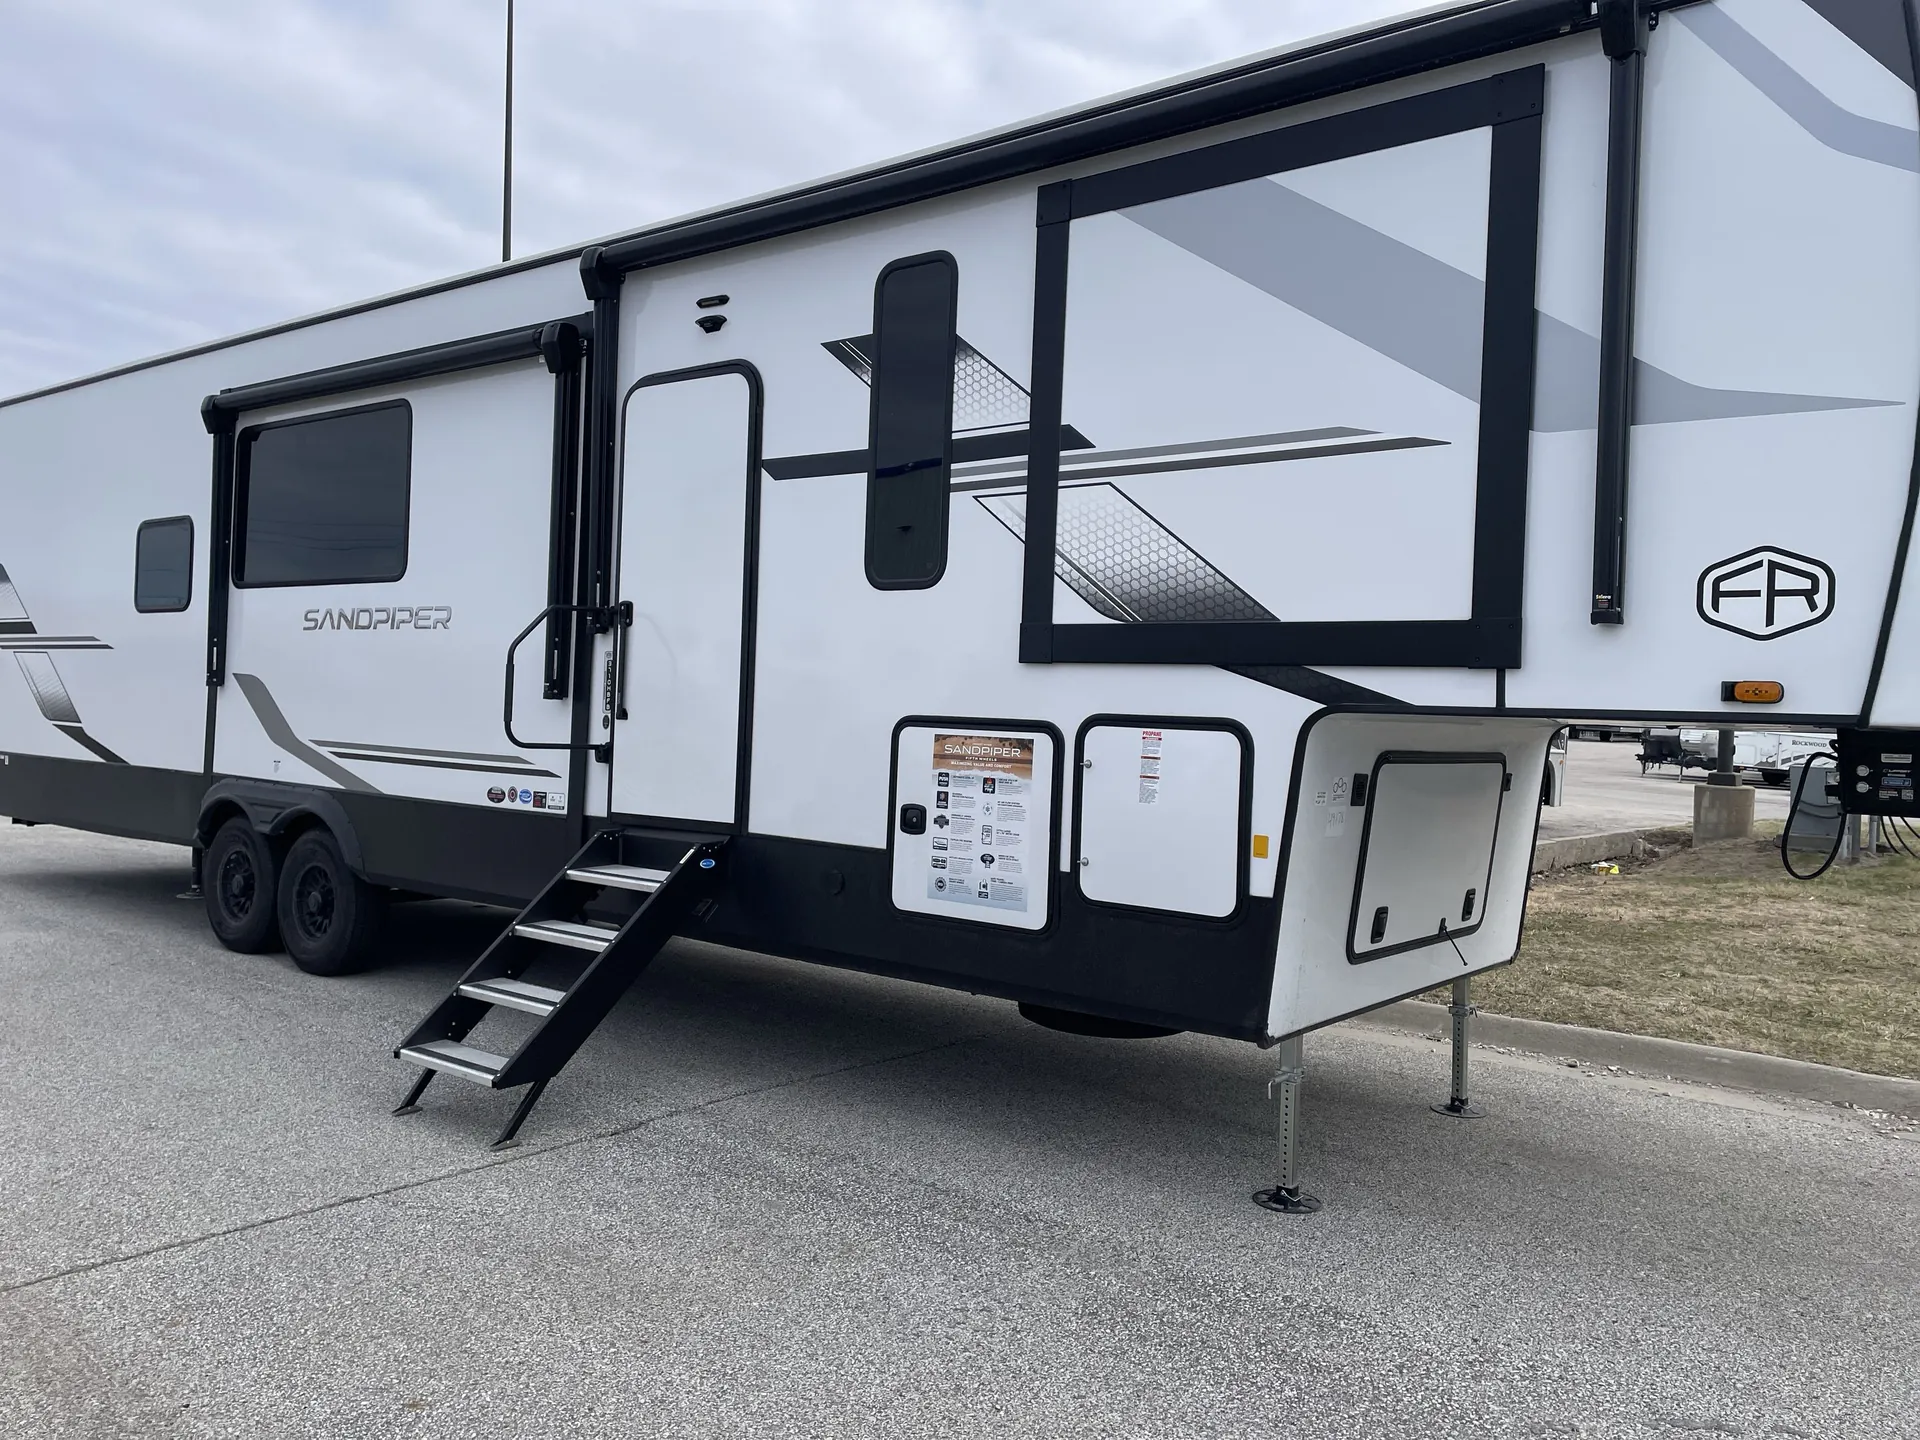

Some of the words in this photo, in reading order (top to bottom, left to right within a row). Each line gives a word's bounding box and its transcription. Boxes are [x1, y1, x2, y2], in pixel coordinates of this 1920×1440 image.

[302, 605, 453, 631] SANDPIPER
[1791, 740, 1828, 748] ROCKWOOD
[944, 745, 1021, 757] SANDPIPER
